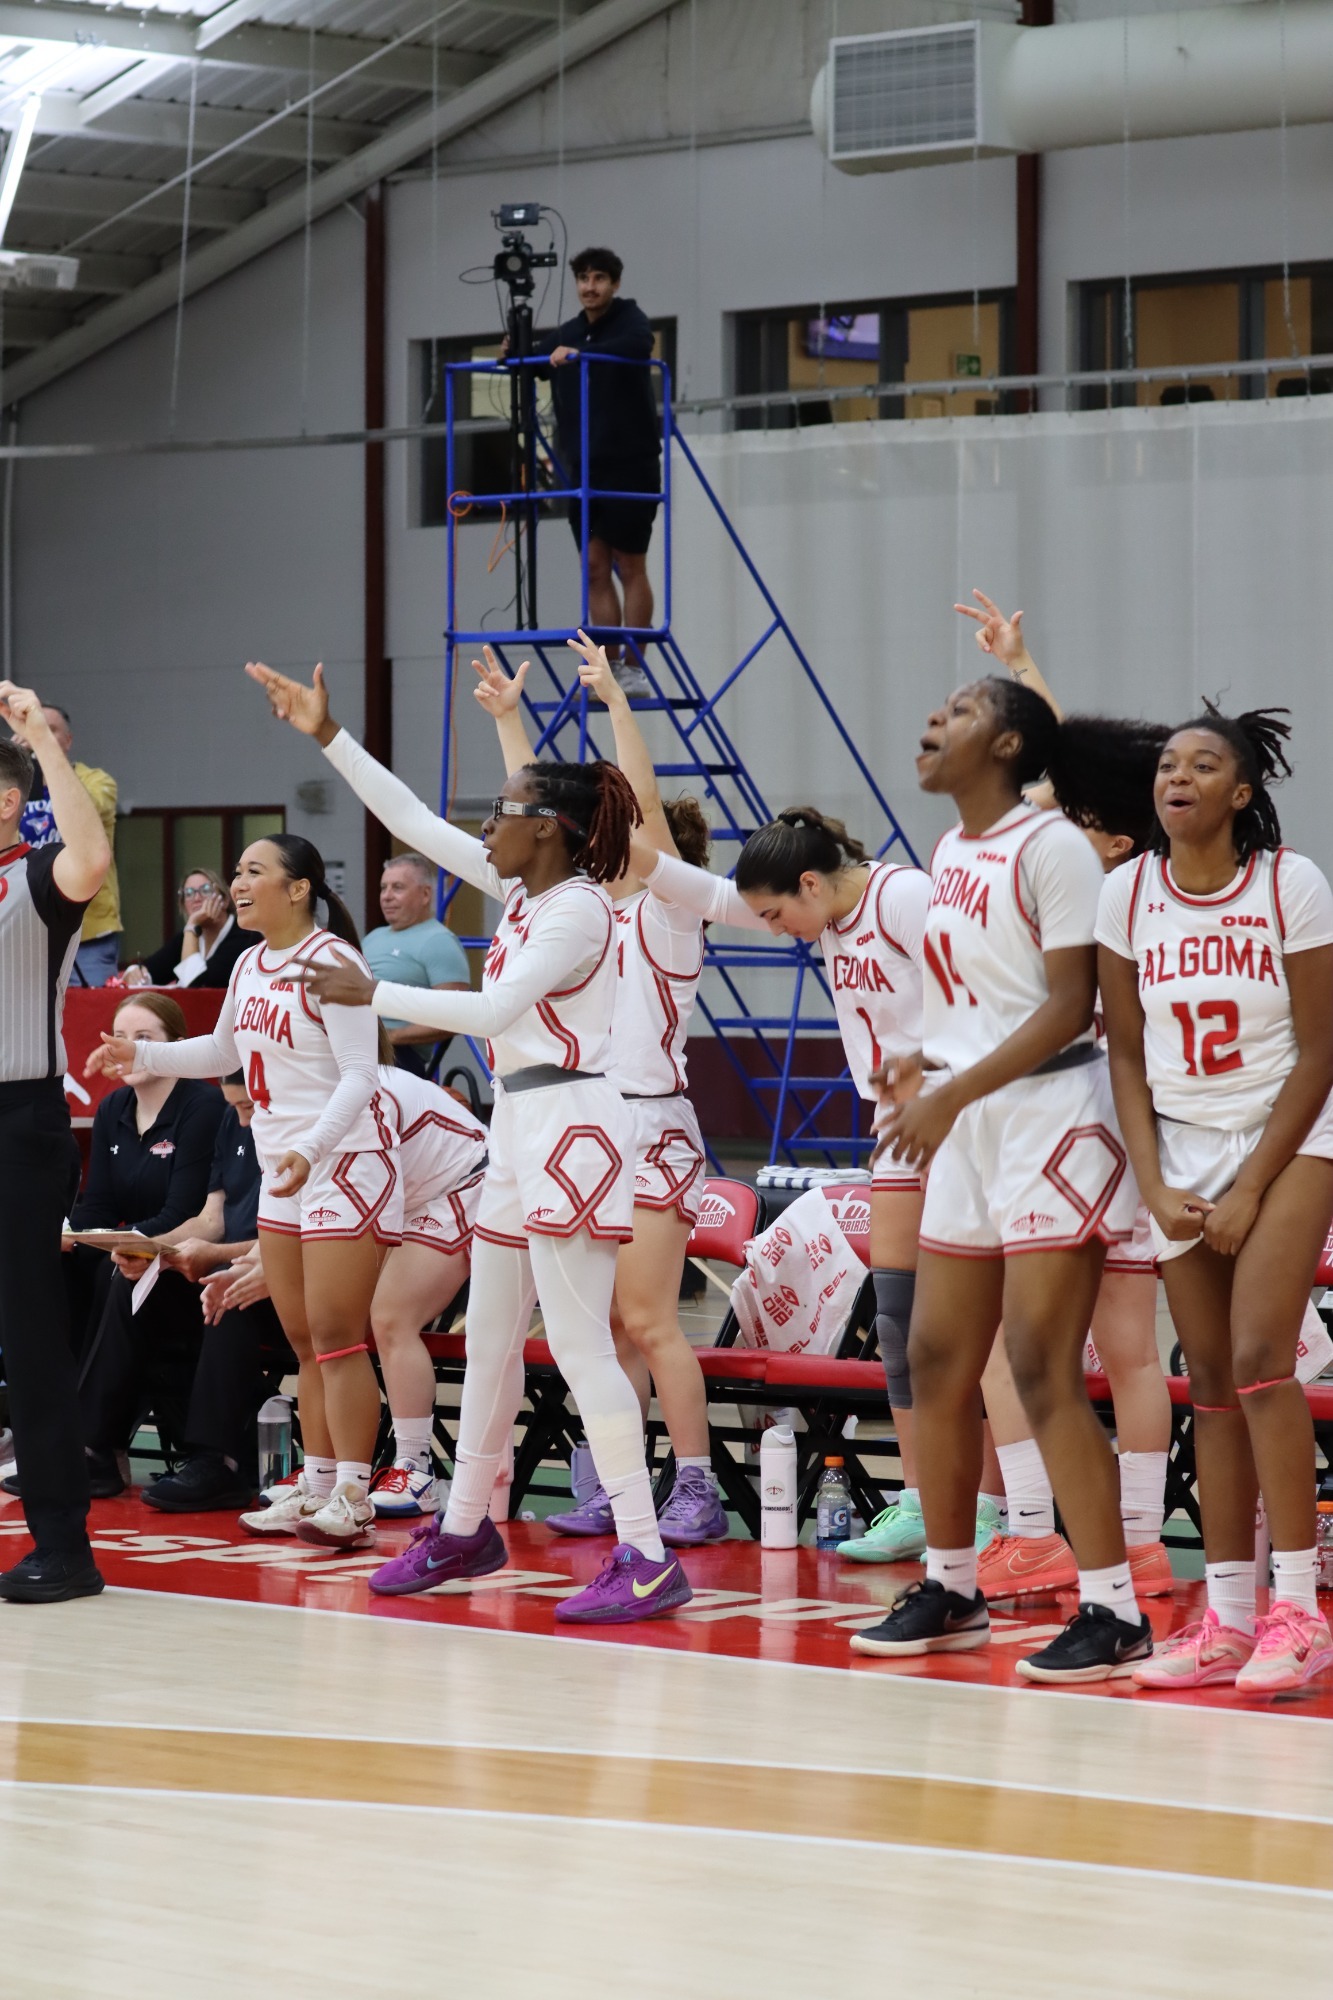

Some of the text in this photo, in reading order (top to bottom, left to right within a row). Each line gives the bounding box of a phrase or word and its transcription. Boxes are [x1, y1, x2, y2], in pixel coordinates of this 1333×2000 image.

[930, 866, 990, 929] GOMA
[1221, 916, 1269, 929] OUA
[856, 930, 875, 946] OUA
[1142, 935, 1280, 992] ALGOMA
[834, 954, 896, 993] LGOMA
[233, 996, 295, 1050] LGOMA
[1170, 1000, 1243, 1076] 12
[248, 1050, 272, 1114] 4
[762, 1296, 790, 1327] BIO
